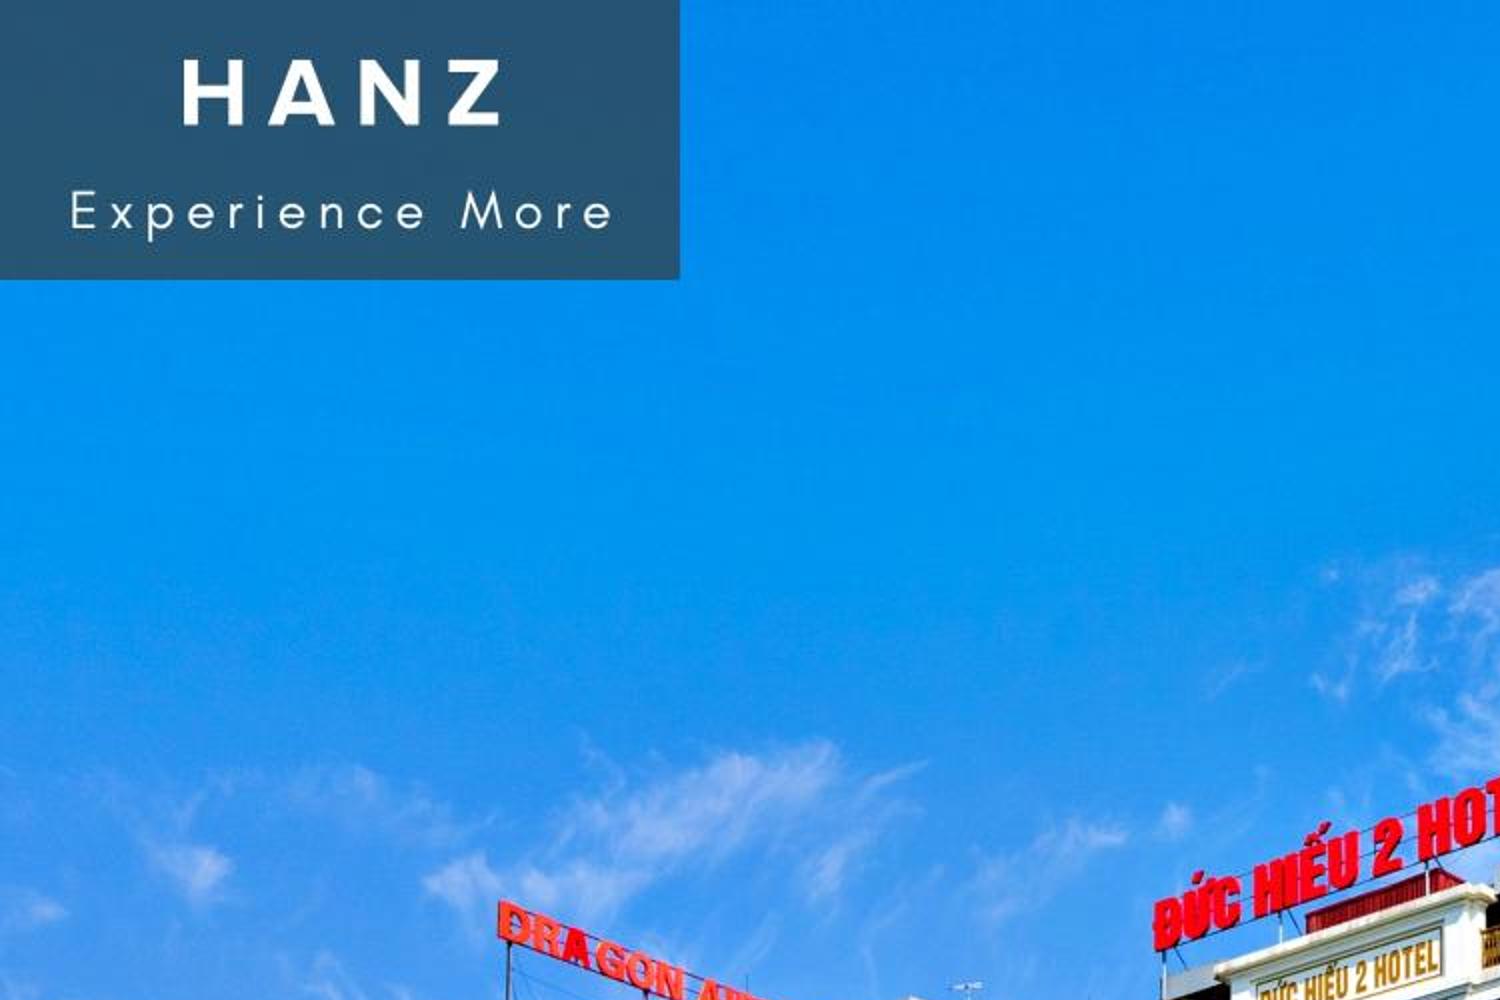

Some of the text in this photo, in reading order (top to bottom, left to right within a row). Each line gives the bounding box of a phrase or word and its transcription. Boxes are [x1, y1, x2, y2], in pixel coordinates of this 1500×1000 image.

[1153, 869, 1242, 953] ĐỨC
[1253, 821, 1360, 917] HIẾU
[1372, 817, 1406, 878] 2
[1355, 959, 1368, 994] 2
[1374, 939, 1439, 988] HOTEL
